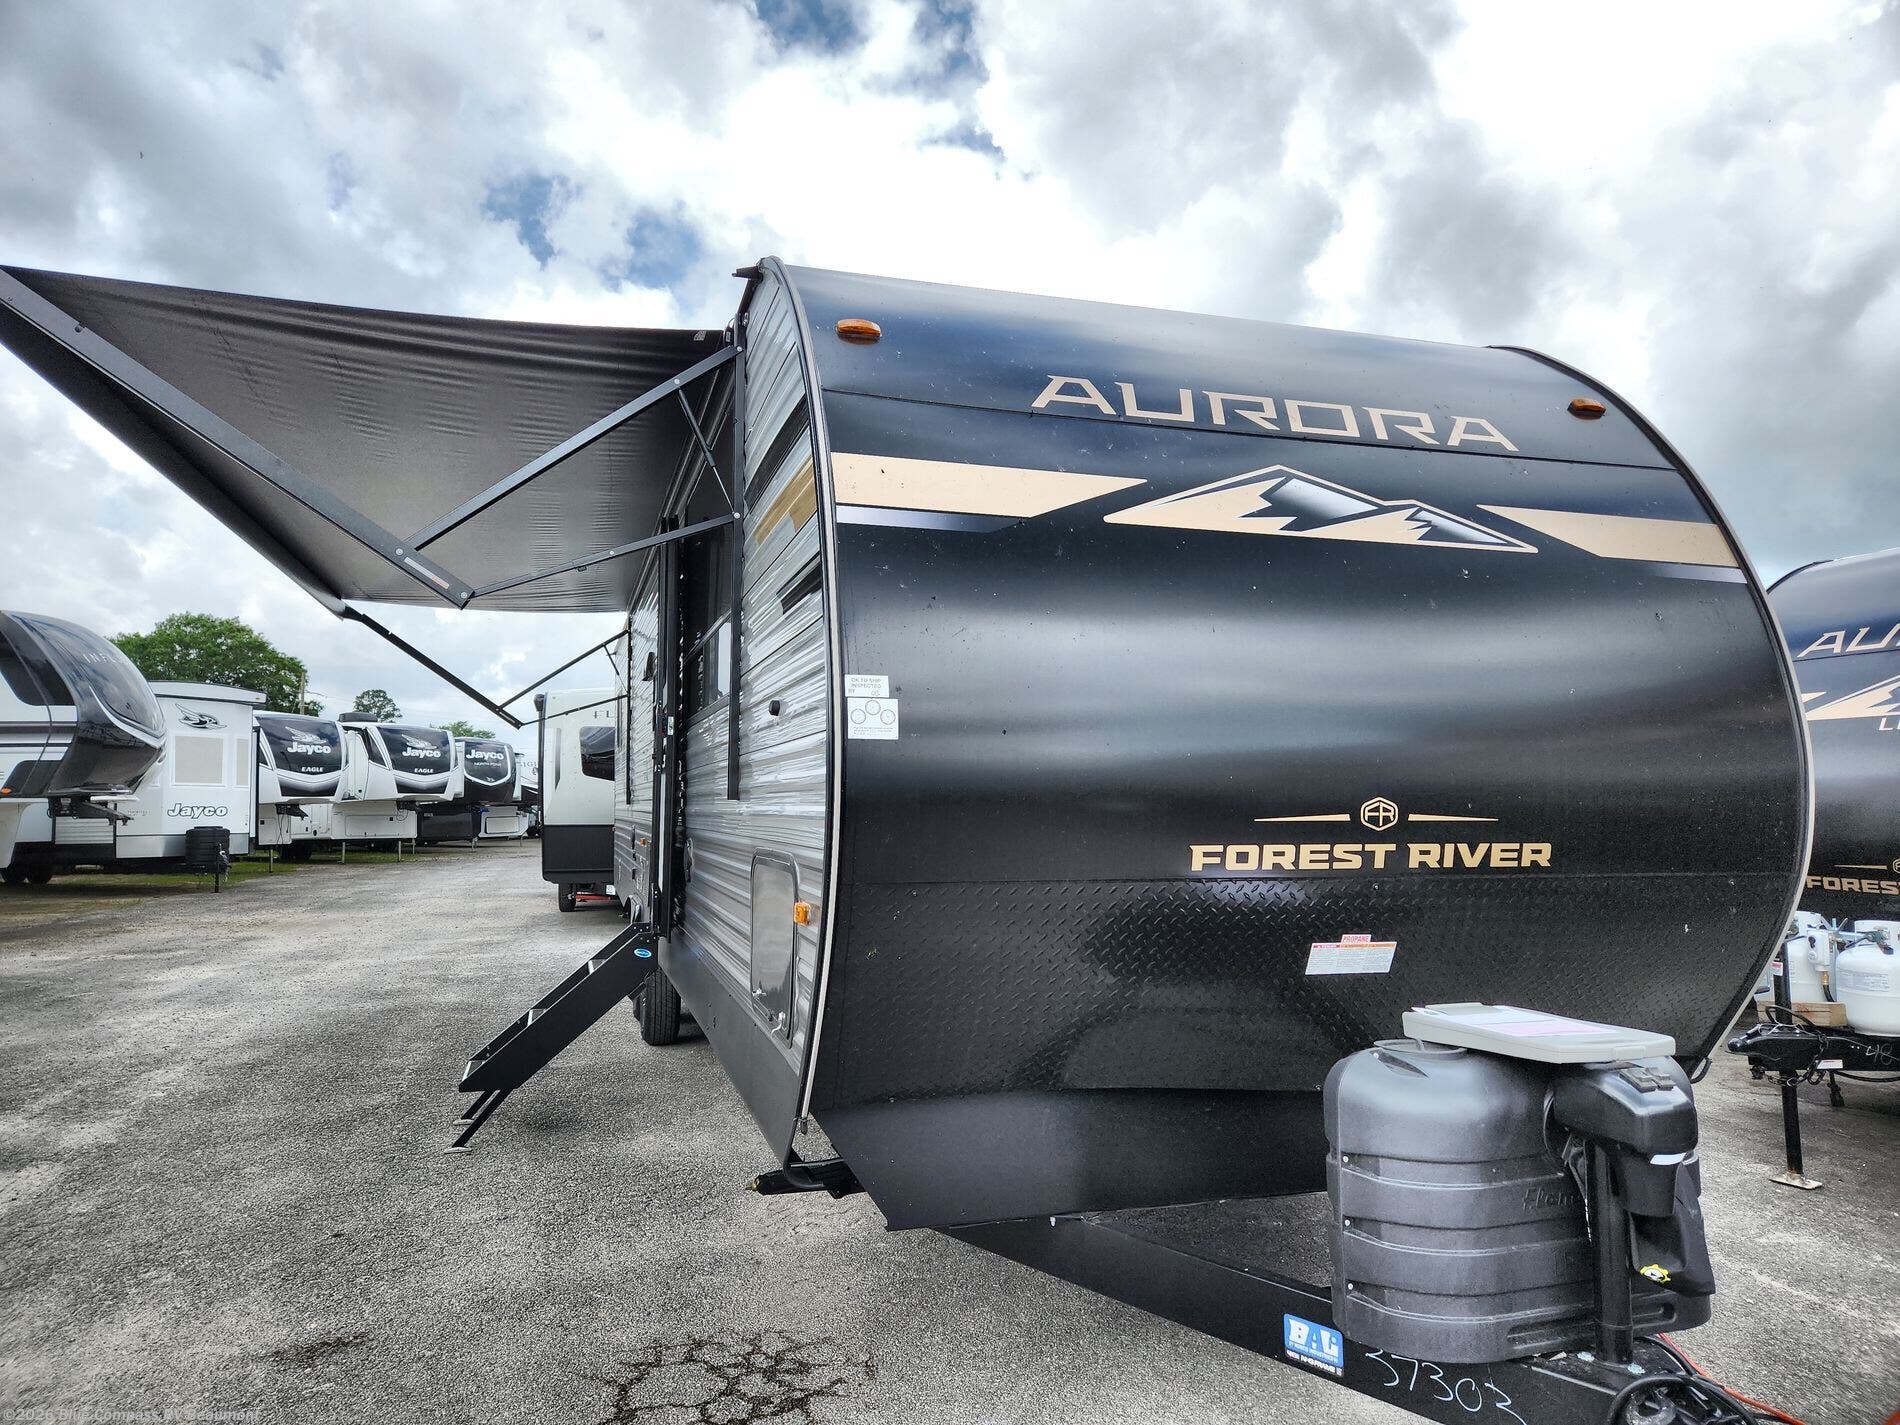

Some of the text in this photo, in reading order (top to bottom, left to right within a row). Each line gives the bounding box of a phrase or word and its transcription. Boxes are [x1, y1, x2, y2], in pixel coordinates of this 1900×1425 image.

[1031, 374, 1519, 452] AURORA
[1797, 622, 1900, 658] AU
[287, 741, 332, 755] Jayco
[402, 746, 442, 759] Jayco
[466, 749, 504, 760] Jayco
[167, 802, 229, 820] Jayco
[1189, 842, 1553, 872] FOREST RIVER
[1806, 875, 1900, 896] FORES
[1342, 934, 1371, 944] PROPANE
